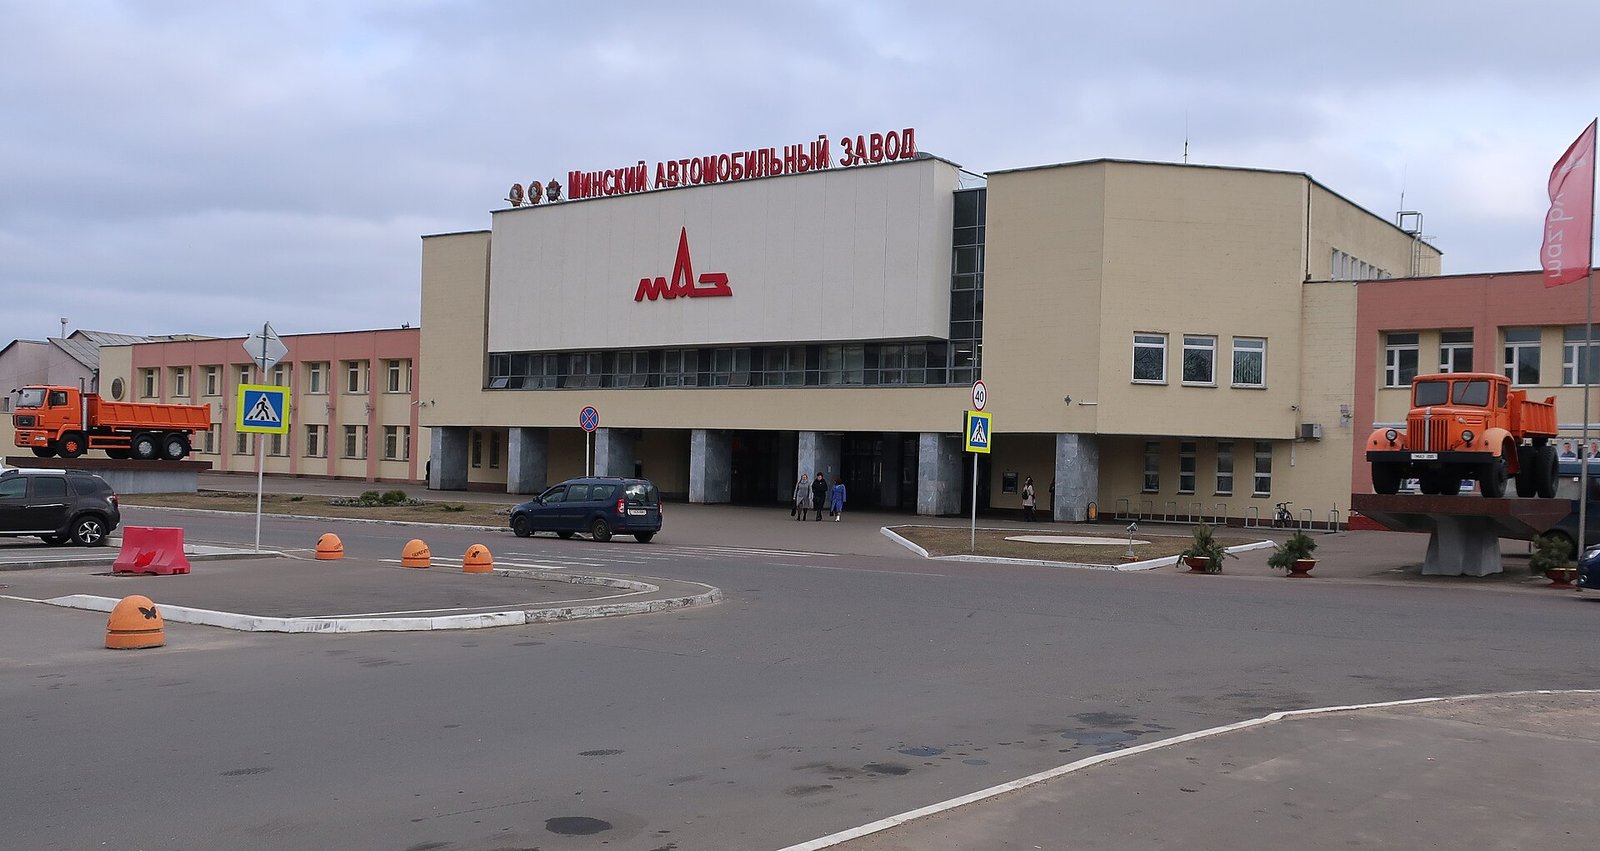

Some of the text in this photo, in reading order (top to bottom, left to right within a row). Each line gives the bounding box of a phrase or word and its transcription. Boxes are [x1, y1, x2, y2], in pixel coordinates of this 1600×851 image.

[568, 128, 915, 199] МИНСКИЙ АВТОМОБИЛЬНЫЙ ЗАВОД
[634, 226, 733, 302] МАЗ
[975, 390, 984, 402] 40
